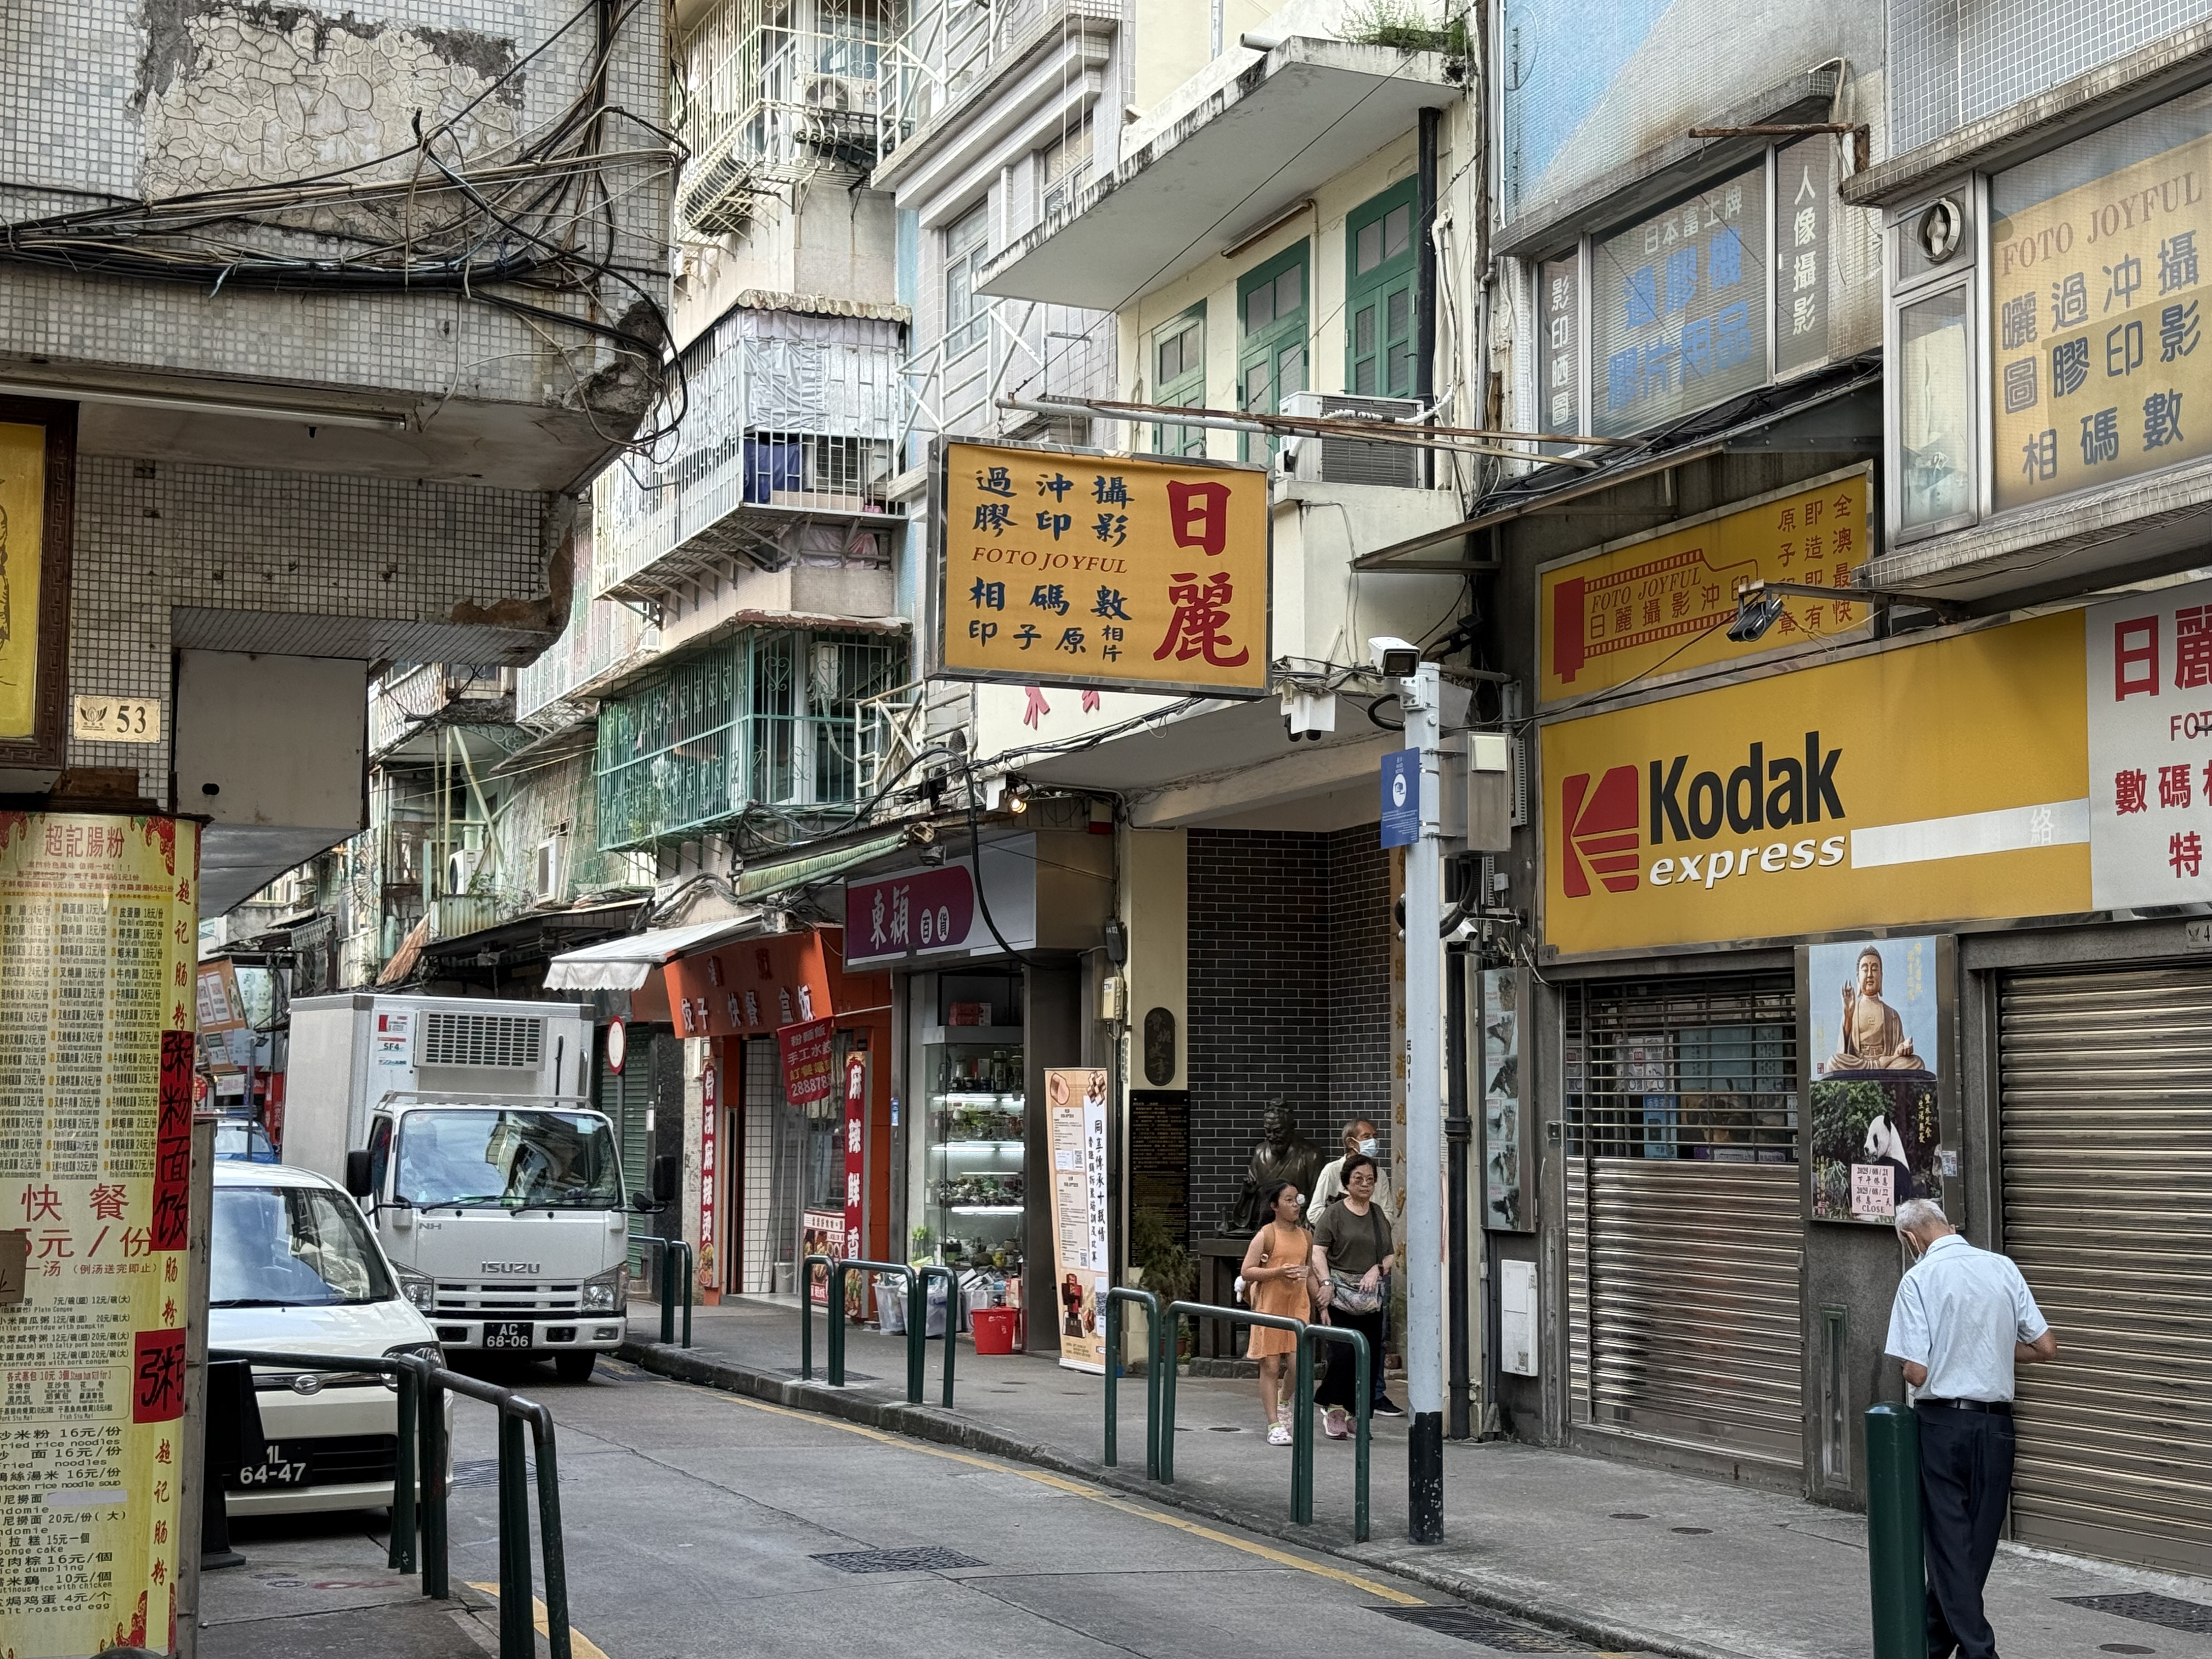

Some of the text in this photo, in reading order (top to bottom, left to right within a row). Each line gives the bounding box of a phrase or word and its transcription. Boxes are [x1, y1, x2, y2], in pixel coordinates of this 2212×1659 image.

[1645, 184, 1742, 254] 日本富士牌
[2001, 171, 2202, 276] FOTO JOYFUL
[1793, 165, 1816, 336] 人像攝影
[2157, 230, 2200, 363] 攝影
[2051, 272, 2090, 398] 過膠
[973, 466, 1017, 537] 過膠
[1091, 475, 1135, 546] 攝影
[972, 548, 1127, 573] FOTO JOYFUL
[1153, 479, 1250, 667] 日麗
[1592, 567, 1701, 613] FOTO JOYFUL
[117, 706, 146, 733] 53
[1650, 730, 1846, 845] Kodak
[45, 824, 125, 858] 超記腸粉
[1649, 835, 1846, 890] express
[2169, 831, 2202, 878] 特
[21, 1183, 129, 1222] 快餐
[1862, 1205, 1884, 1213] CLOSE
[481, 1262, 540, 1274] ISUZU
[487, 1335, 529, 1347] 68-06
[500, 1324, 518, 1335] AC
[139, 1343, 185, 1411] 粥
[60, 1426, 122, 1438] 16元/份
[55, 1446, 122, 1458] 16元/份
[67, 1468, 121, 1479] 16元/份
[240, 1463, 306, 1483] 64-47
[0, 1494, 42, 1504] 尼撈面
[0, 1515, 42, 1526] 尼撈面
[0, 1533, 89, 1547] 拉糕 15元一個
[25, 1565, 83, 1573] dumpling
[48, 1552, 112, 1564] 16元/個
[56, 1571, 111, 1583] 10元/個
[0, 1591, 111, 1606] 焗鸡蛋 4元/个
[28, 1604, 81, 1613] roasted
